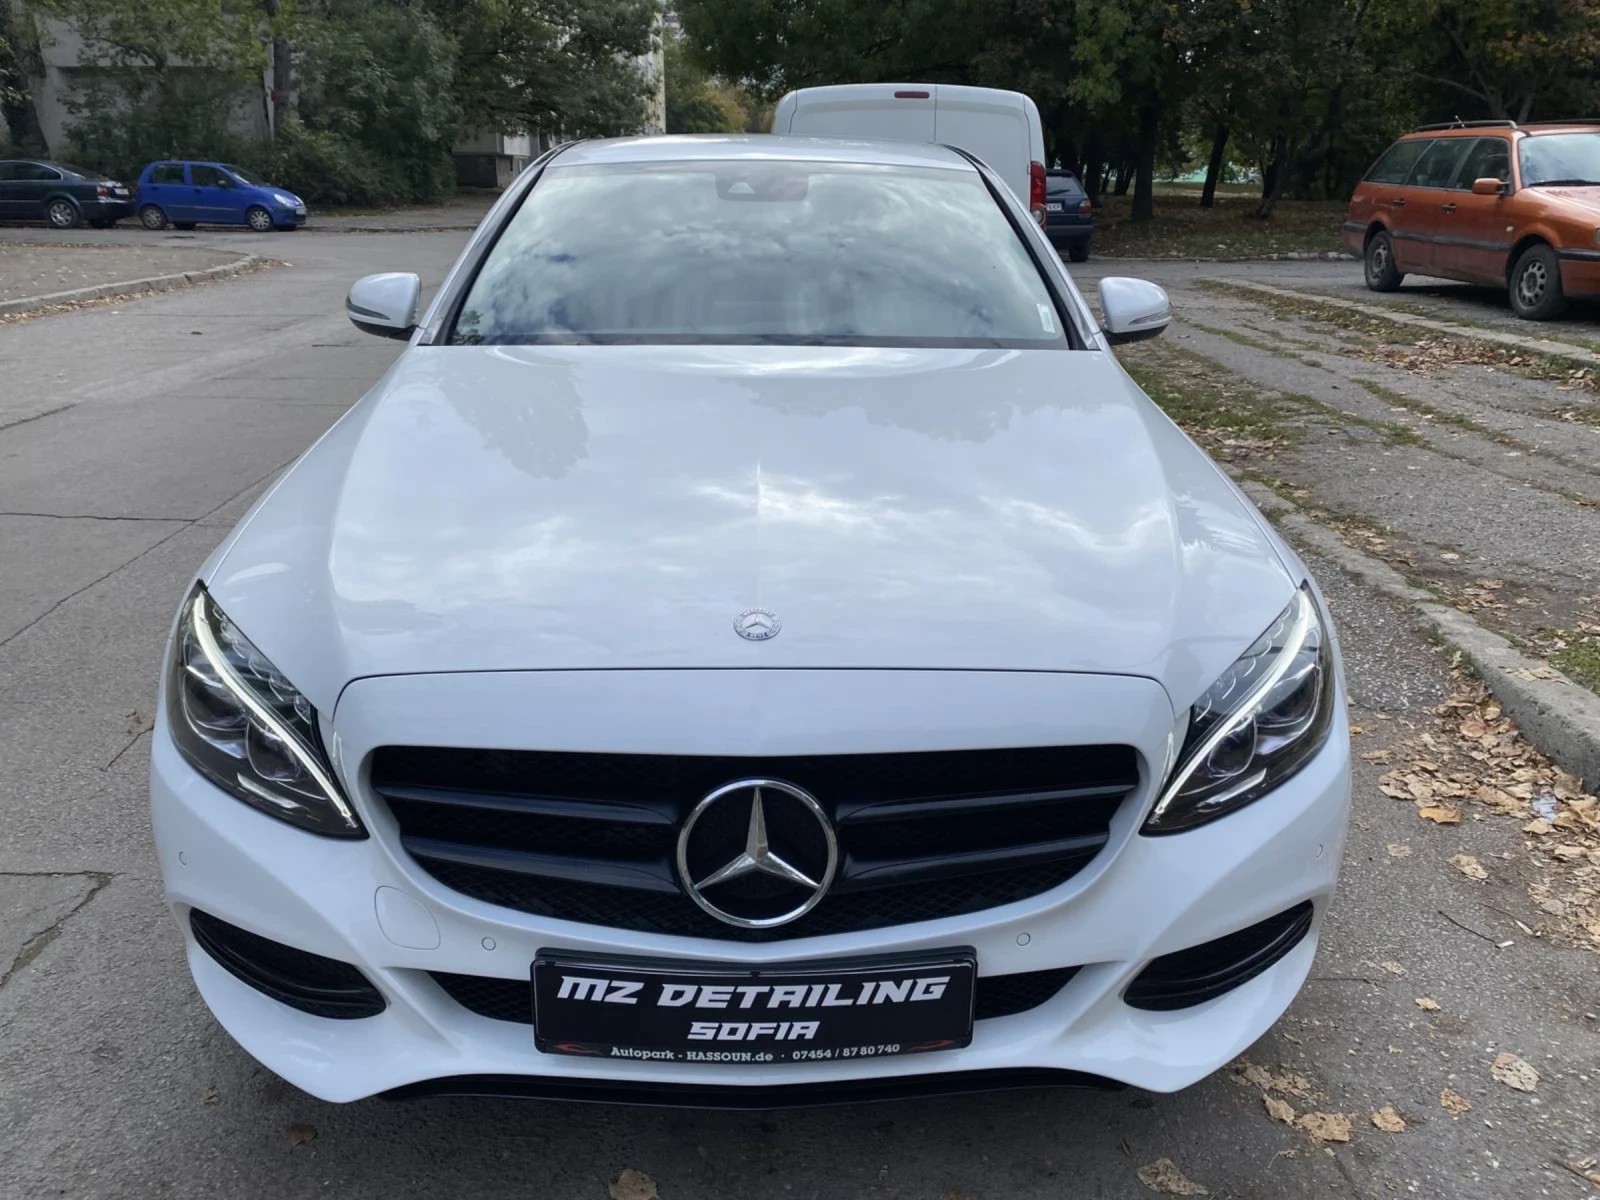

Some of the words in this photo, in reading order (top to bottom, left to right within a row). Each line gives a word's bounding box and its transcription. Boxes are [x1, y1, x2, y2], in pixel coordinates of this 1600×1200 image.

[557, 975, 645, 1004] MZ
[657, 976, 951, 1009] DETAILING
[687, 1021, 821, 1041] SOFIA
[610, 1046, 675, 1060] Autopark
[686, 1051, 774, 1062] HASSOUN.de
[792, 1049, 832, 1060] 07454
